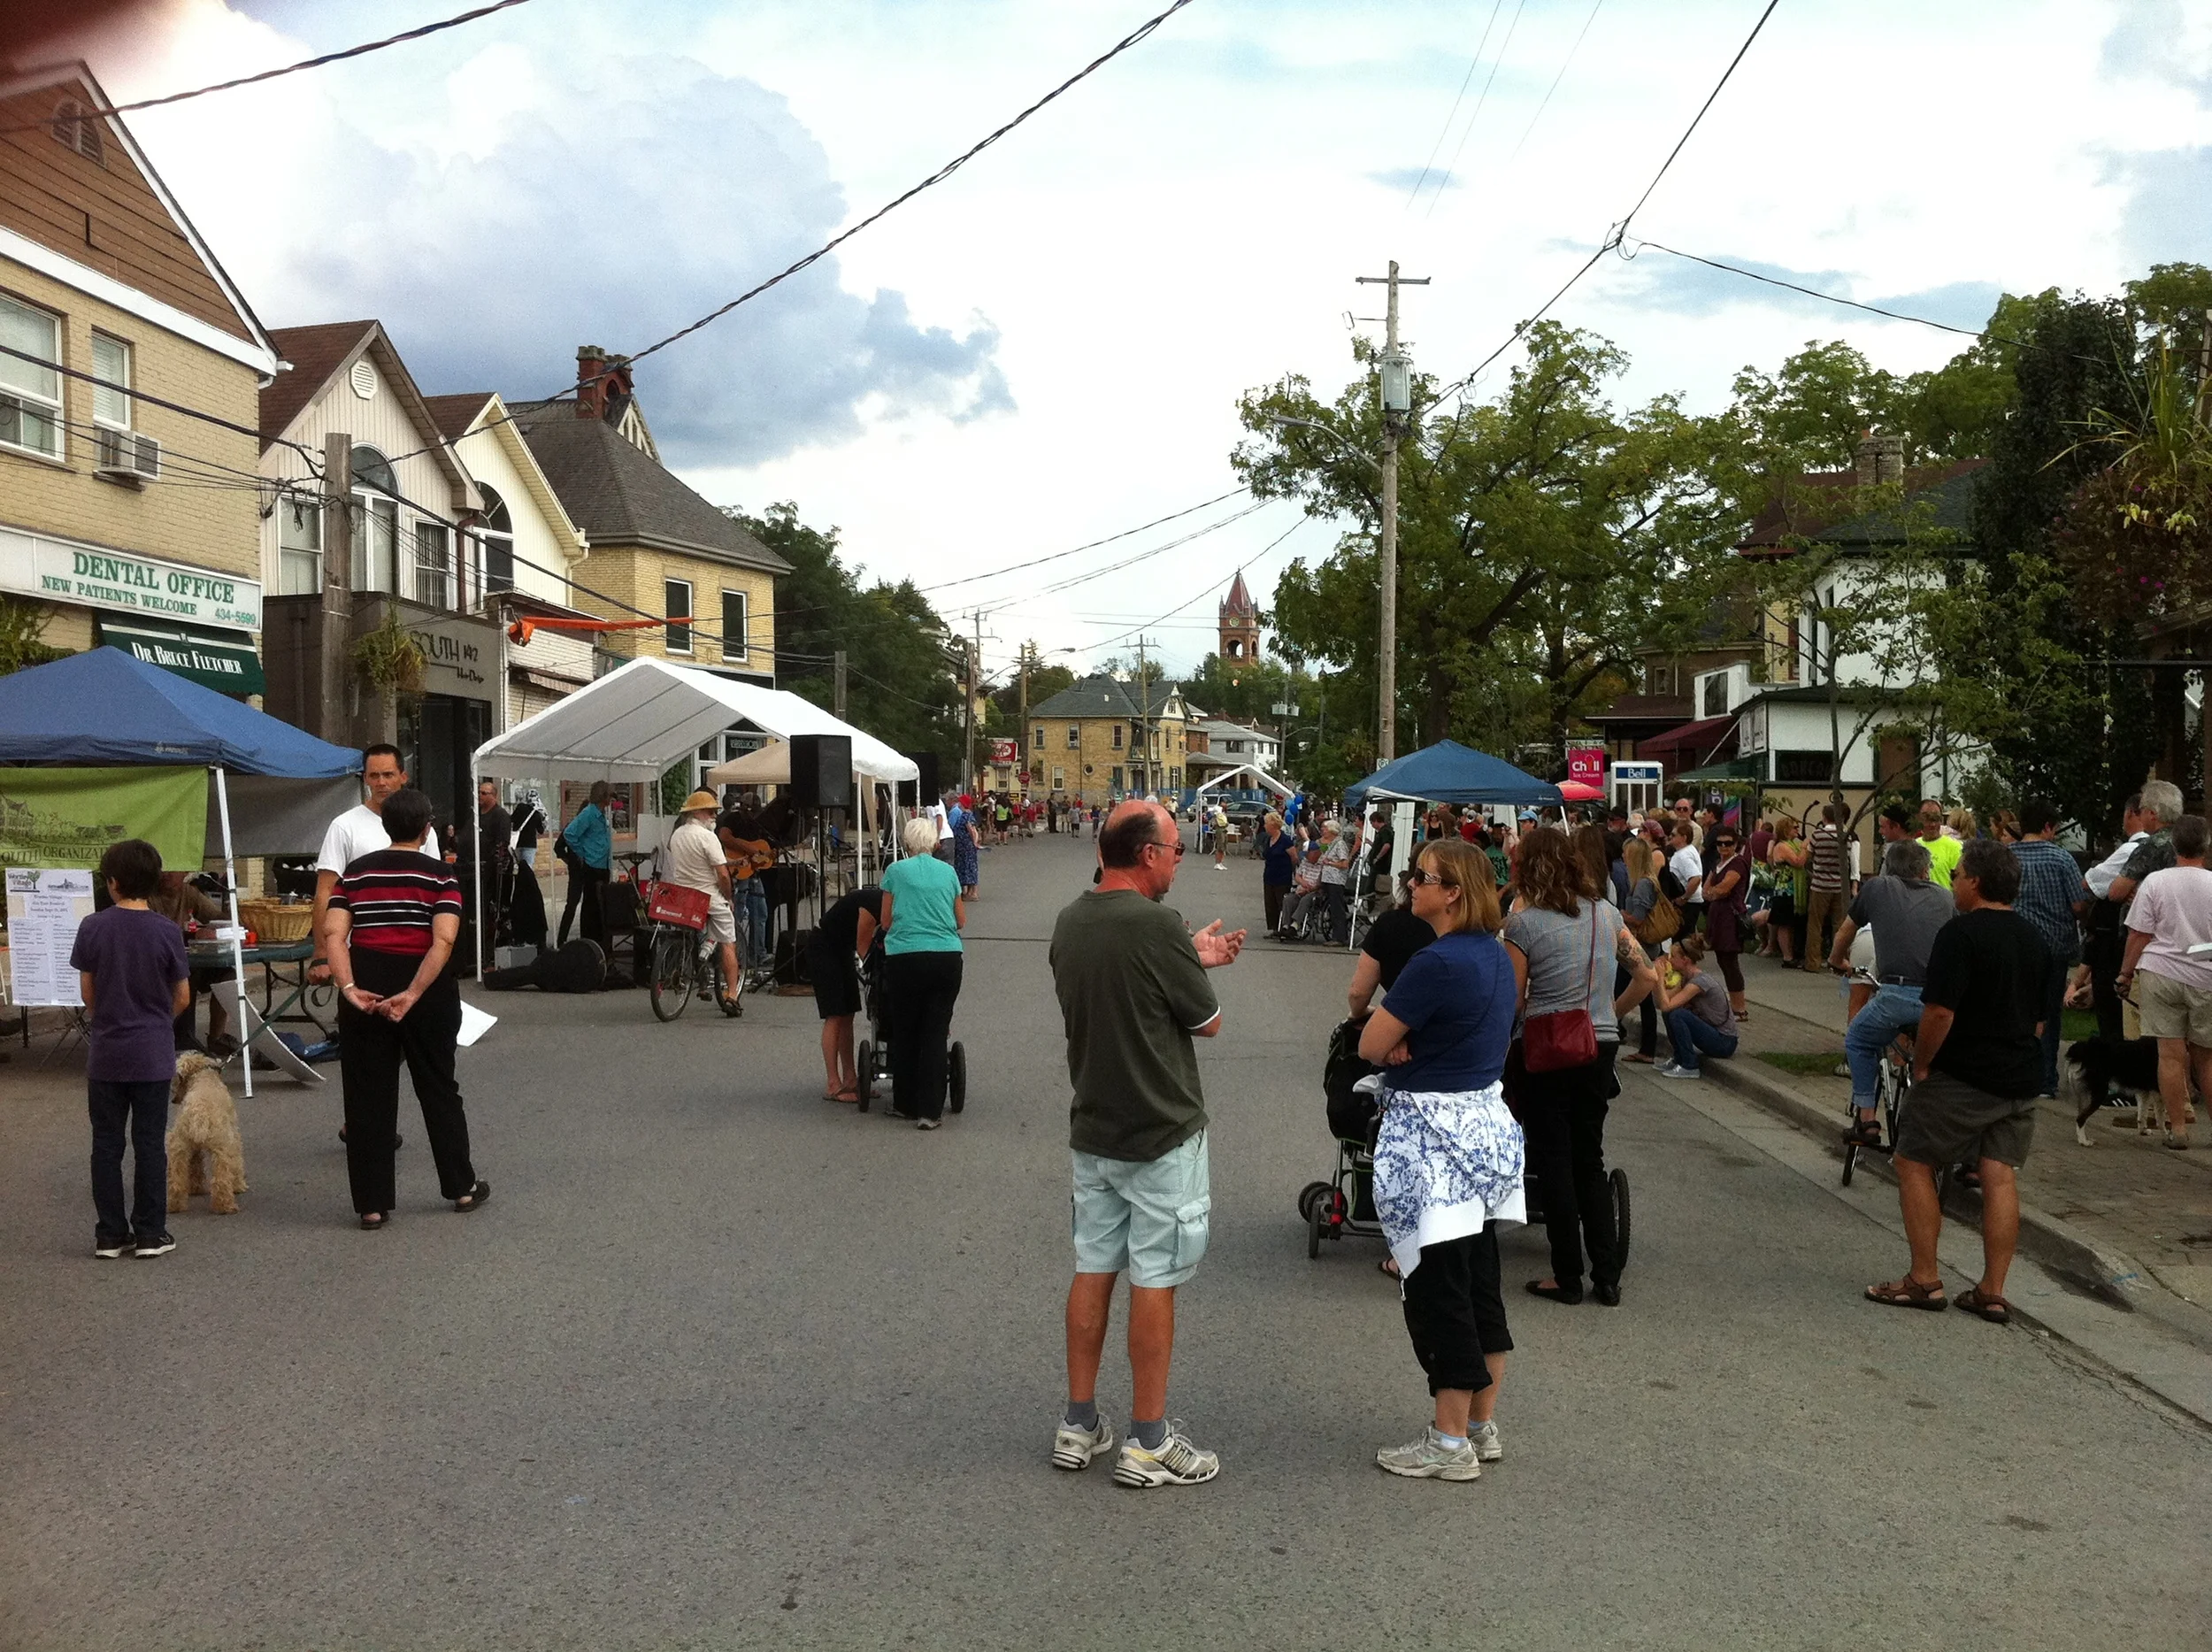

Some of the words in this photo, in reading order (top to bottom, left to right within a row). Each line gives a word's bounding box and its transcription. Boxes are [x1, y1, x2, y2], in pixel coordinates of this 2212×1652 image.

[73, 551, 159, 590] DENTAL
[167, 572, 234, 603] OFFICE
[42, 575, 71, 593] NEW
[77, 581, 137, 605] PATIENTS
[142, 595, 197, 615] WELCOME
[153, 644, 192, 668] BRUCE
[191, 650, 244, 674] FLETCHER
[1628, 768, 1647, 778] Bell
[1, 849, 38, 864] OUTH
[43, 846, 108, 860] ORGANIZAT
